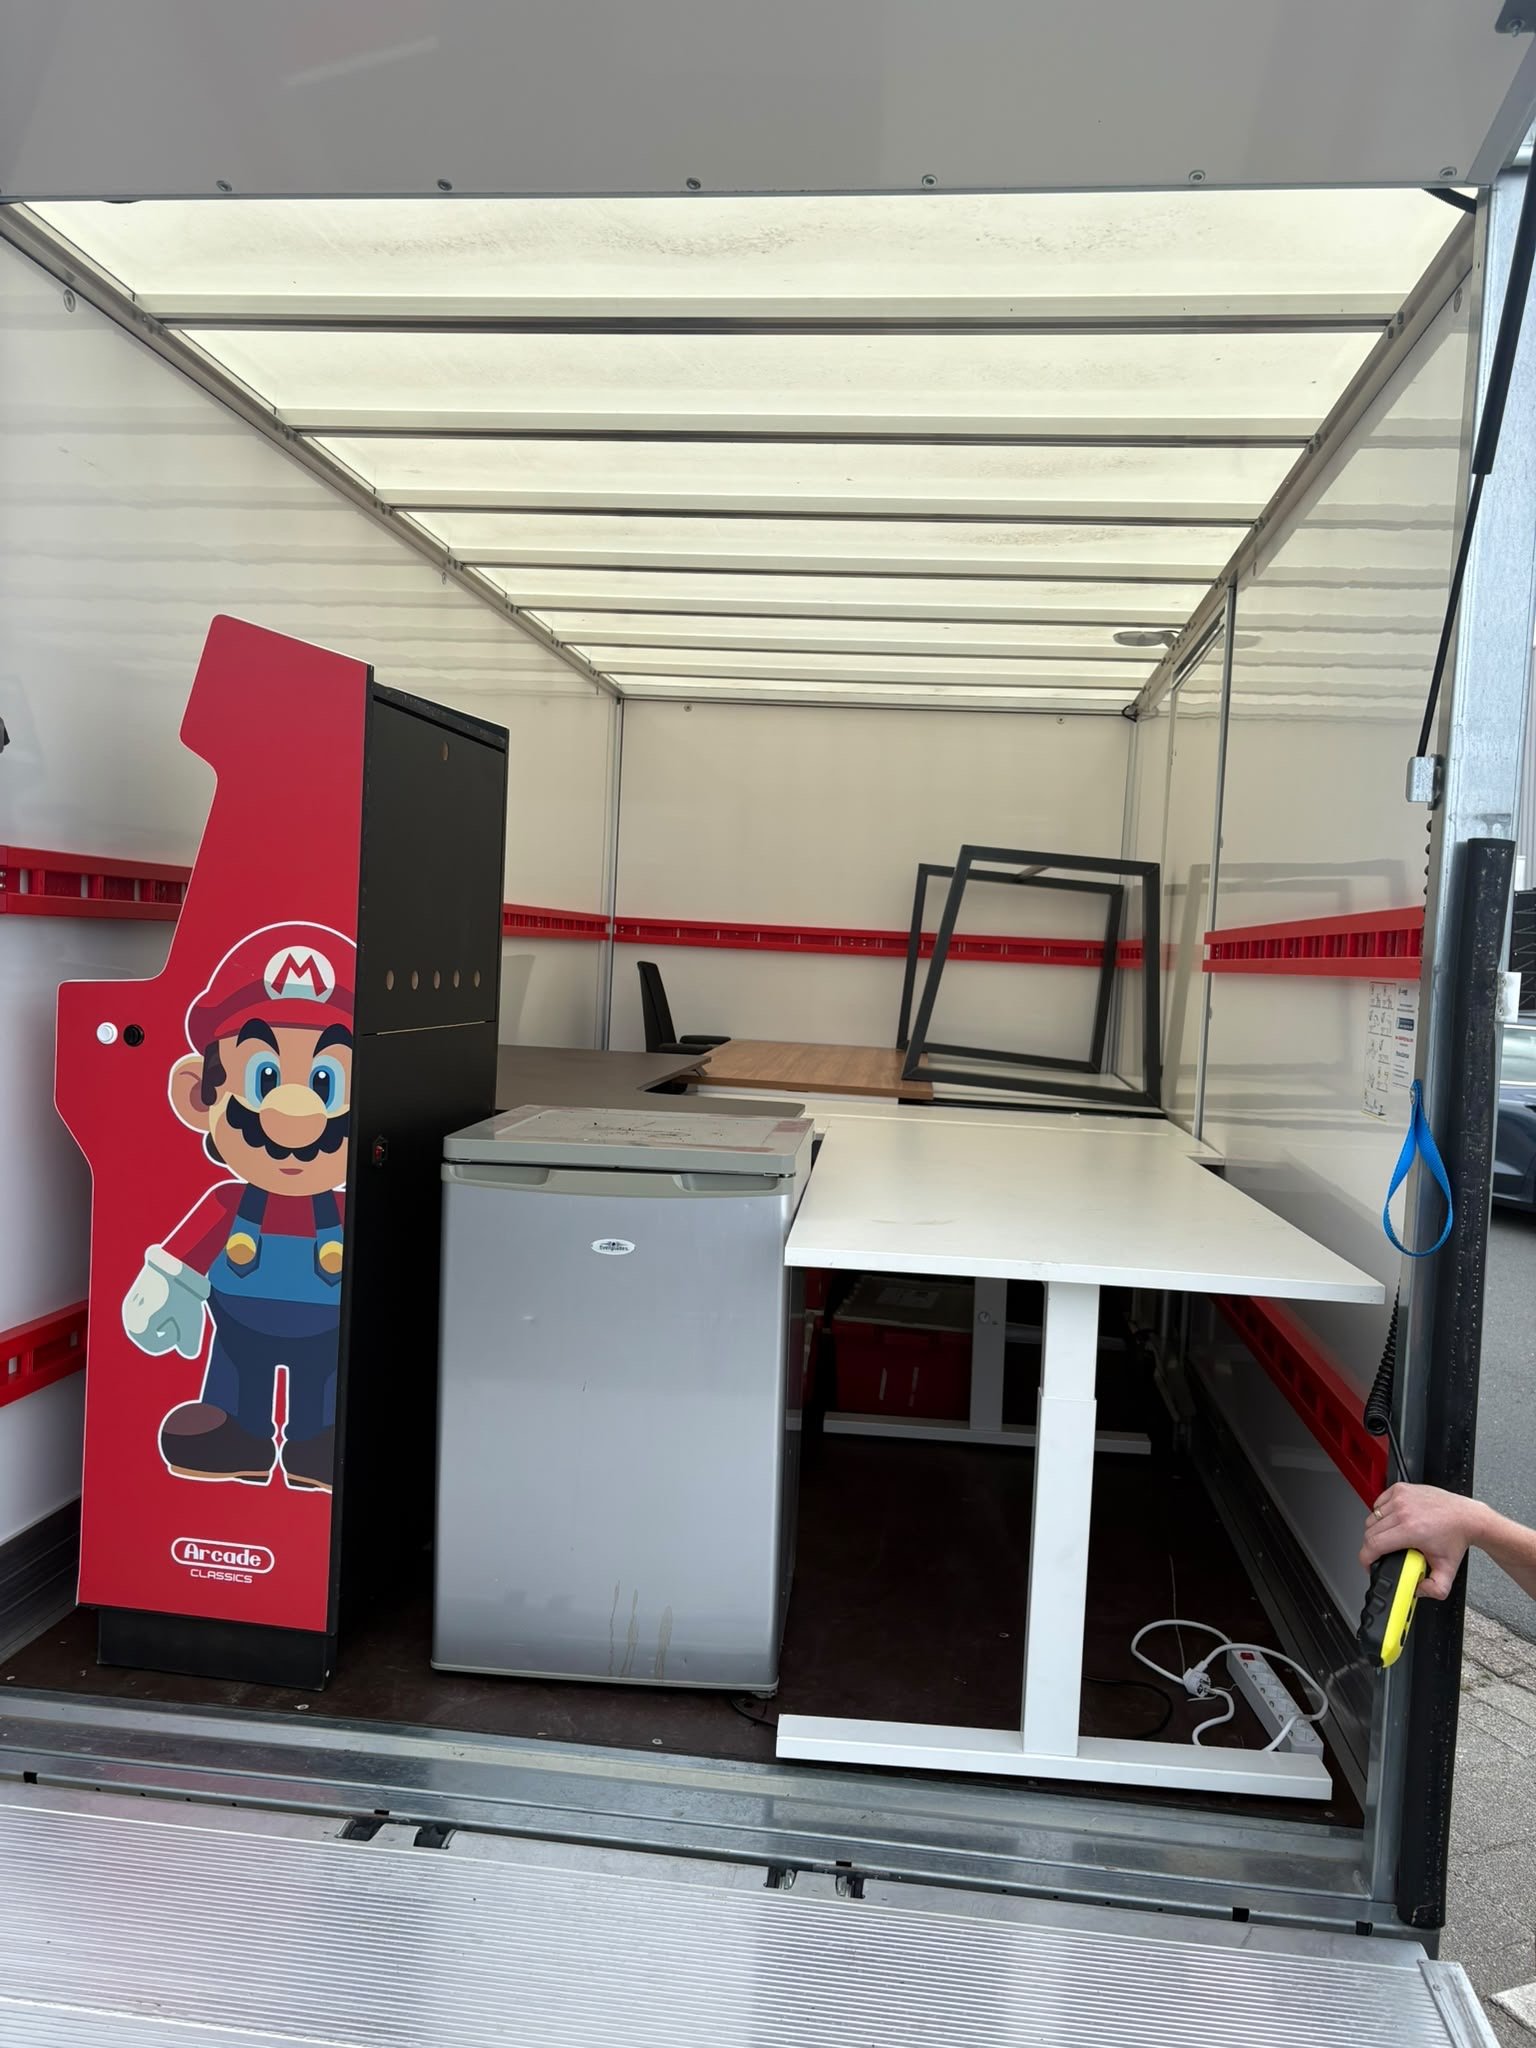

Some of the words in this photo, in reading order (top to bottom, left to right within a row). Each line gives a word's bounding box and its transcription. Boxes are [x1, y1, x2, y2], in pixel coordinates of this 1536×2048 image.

[271, 952, 328, 997] M
[183, 1543, 262, 1567] Arcade
[190, 1568, 253, 1584] CLASSICS
